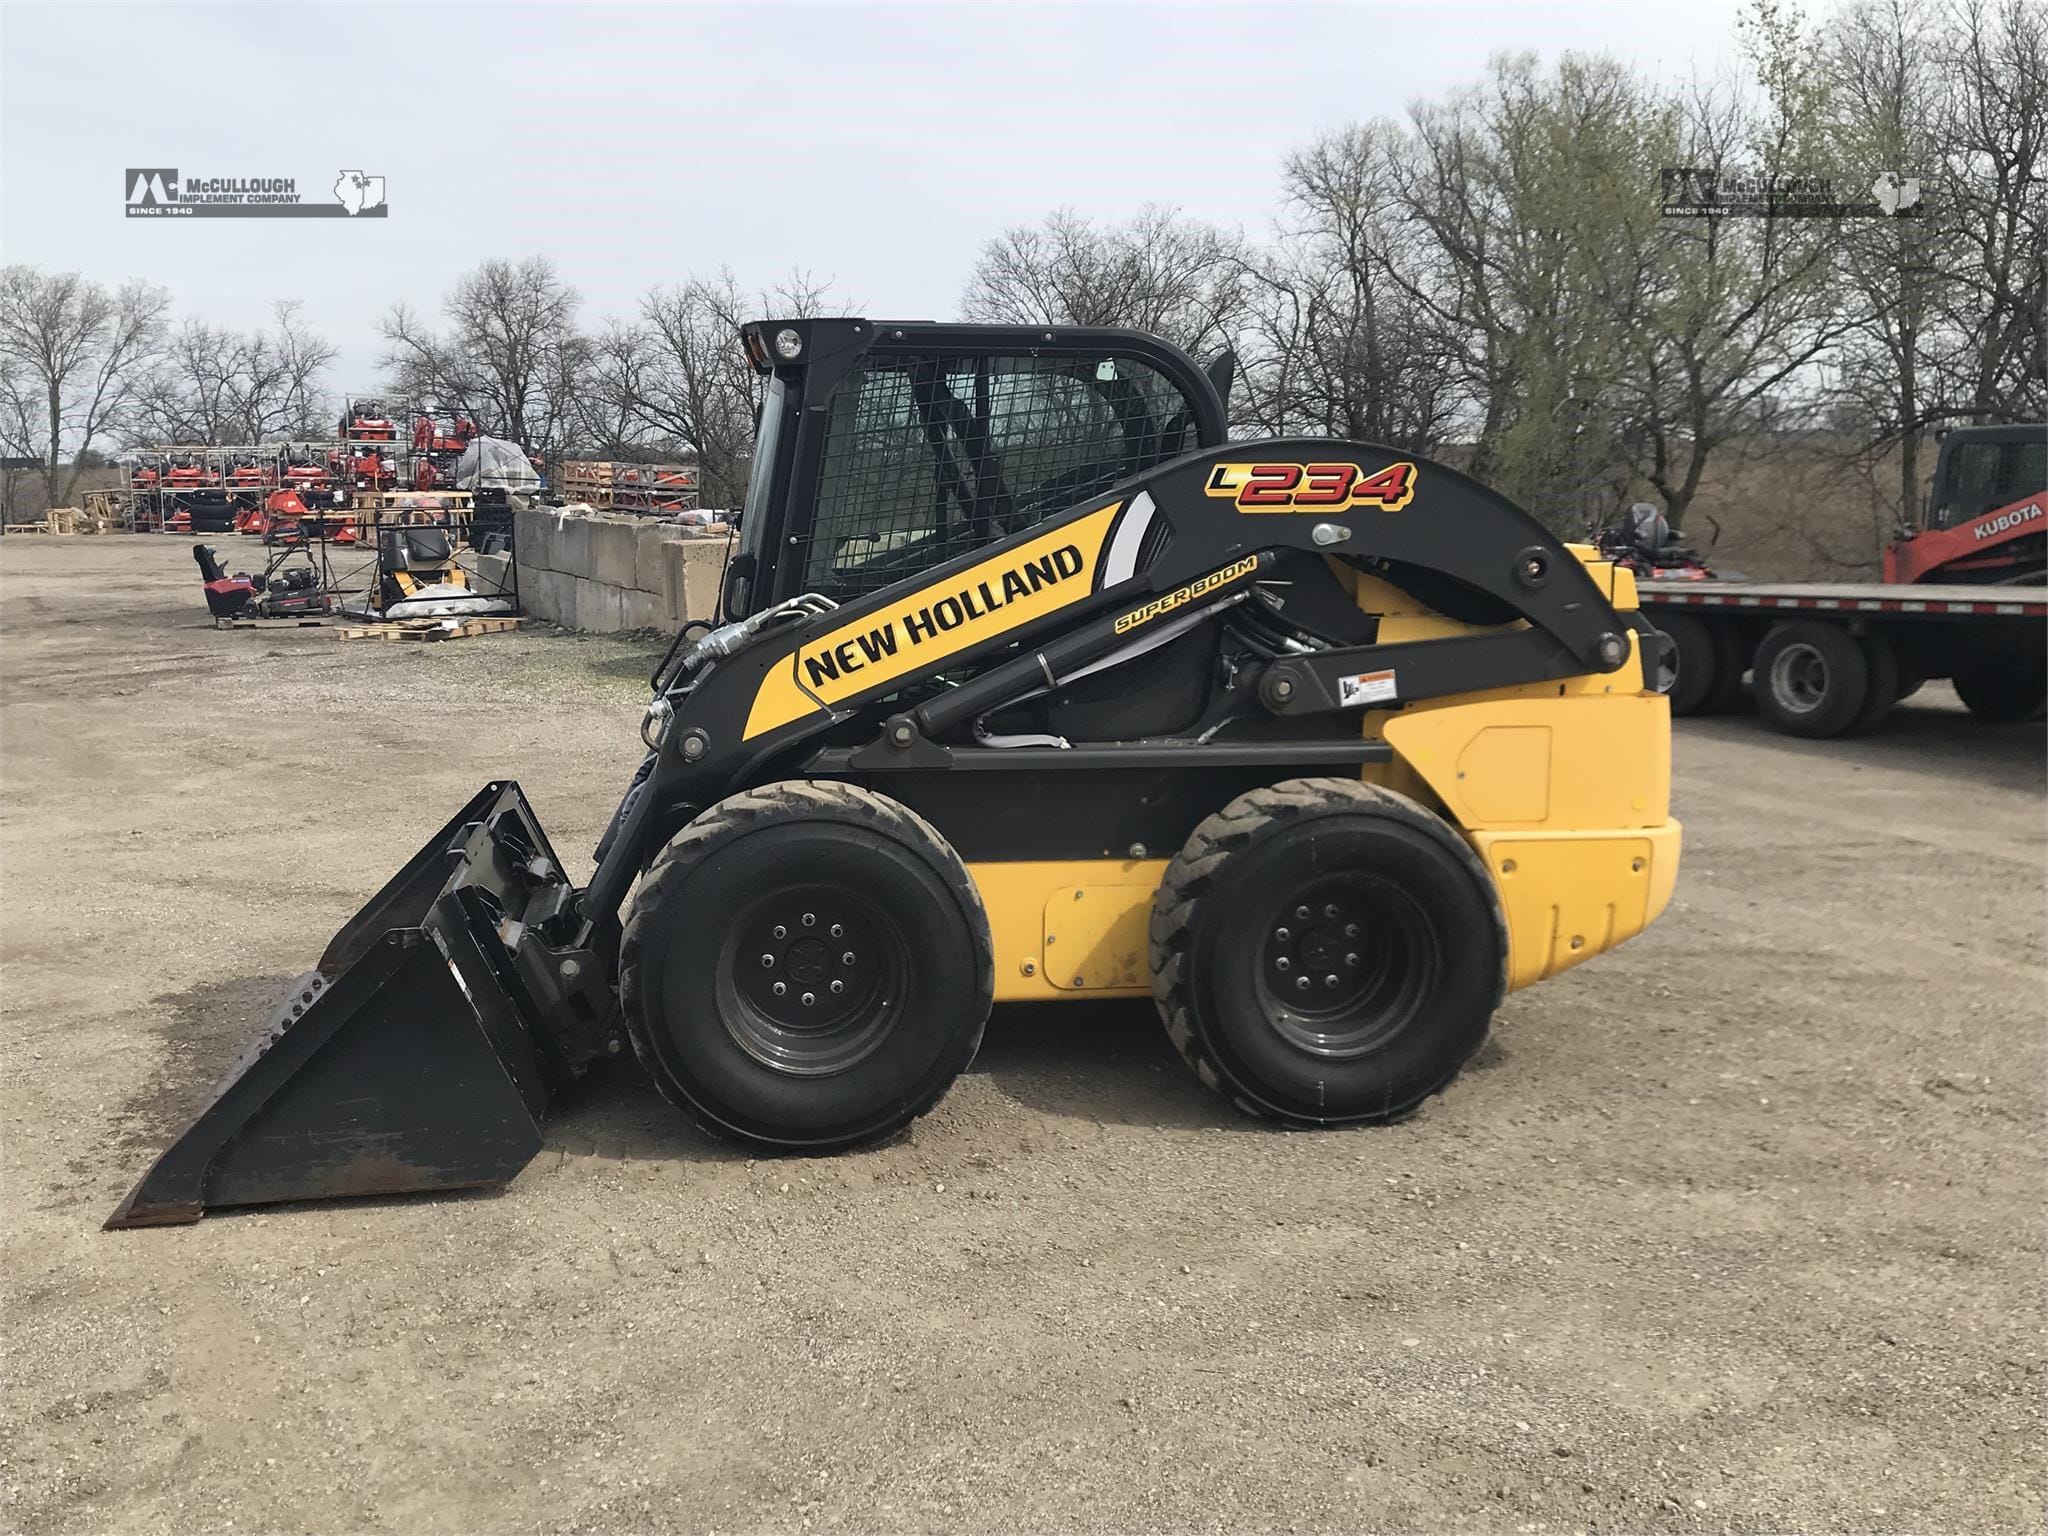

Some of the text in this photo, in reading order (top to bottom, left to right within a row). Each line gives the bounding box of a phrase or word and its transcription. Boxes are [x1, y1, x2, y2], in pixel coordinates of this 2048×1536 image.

[1207, 464, 1413, 508] L234
[1973, 503, 2043, 540] KUBOTA
[804, 543, 1084, 688] NEW HOLLAND
